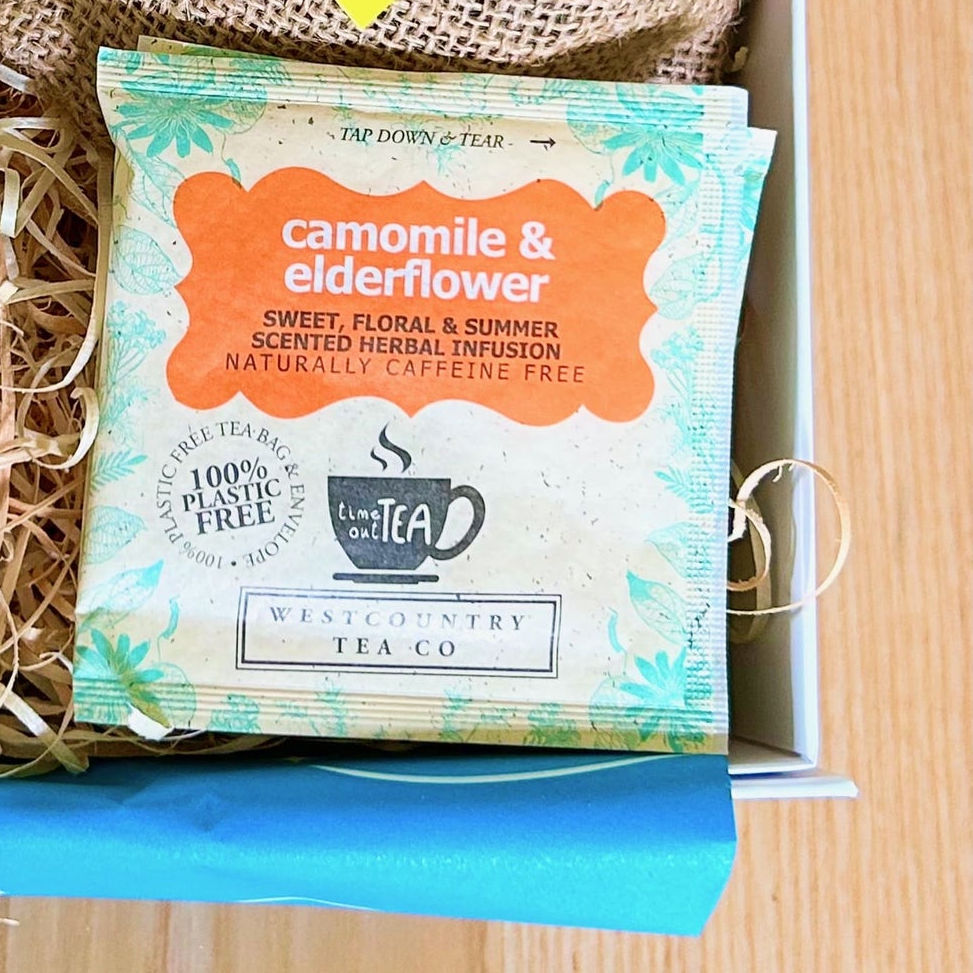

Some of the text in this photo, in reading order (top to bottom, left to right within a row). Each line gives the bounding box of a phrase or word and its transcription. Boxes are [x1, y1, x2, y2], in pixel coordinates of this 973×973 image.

[339, 126, 505, 149] TAP DOWN & TEAR
[280, 216, 556, 261] camomile &
[283, 253, 550, 304] elderflower
[262, 309, 559, 339] SWEET, FLORAL & SUMMER
[251, 331, 561, 360] SCENTED HERBAL INFUSION
[225, 352, 586, 384] NATURALLY CAFFEINE FREE
[170, 425, 215, 464] FREE
[256, 428, 292, 461] BAG
[189, 455, 268, 491] 100%
[284, 462, 300, 479] &
[156, 464, 183, 544] PLASTIC
[181, 478, 282, 513] PLASTIC
[338, 501, 381, 521] time
[194, 499, 276, 536] FREE
[243, 484, 305, 568] ENVELOPE
[349, 522, 379, 541] out
[377, 497, 432, 545] TEA
[180, 540, 222, 570] 100%
[269, 606, 527, 630] WESTCOUNTRY
[332, 636, 456, 658] TEA CO
